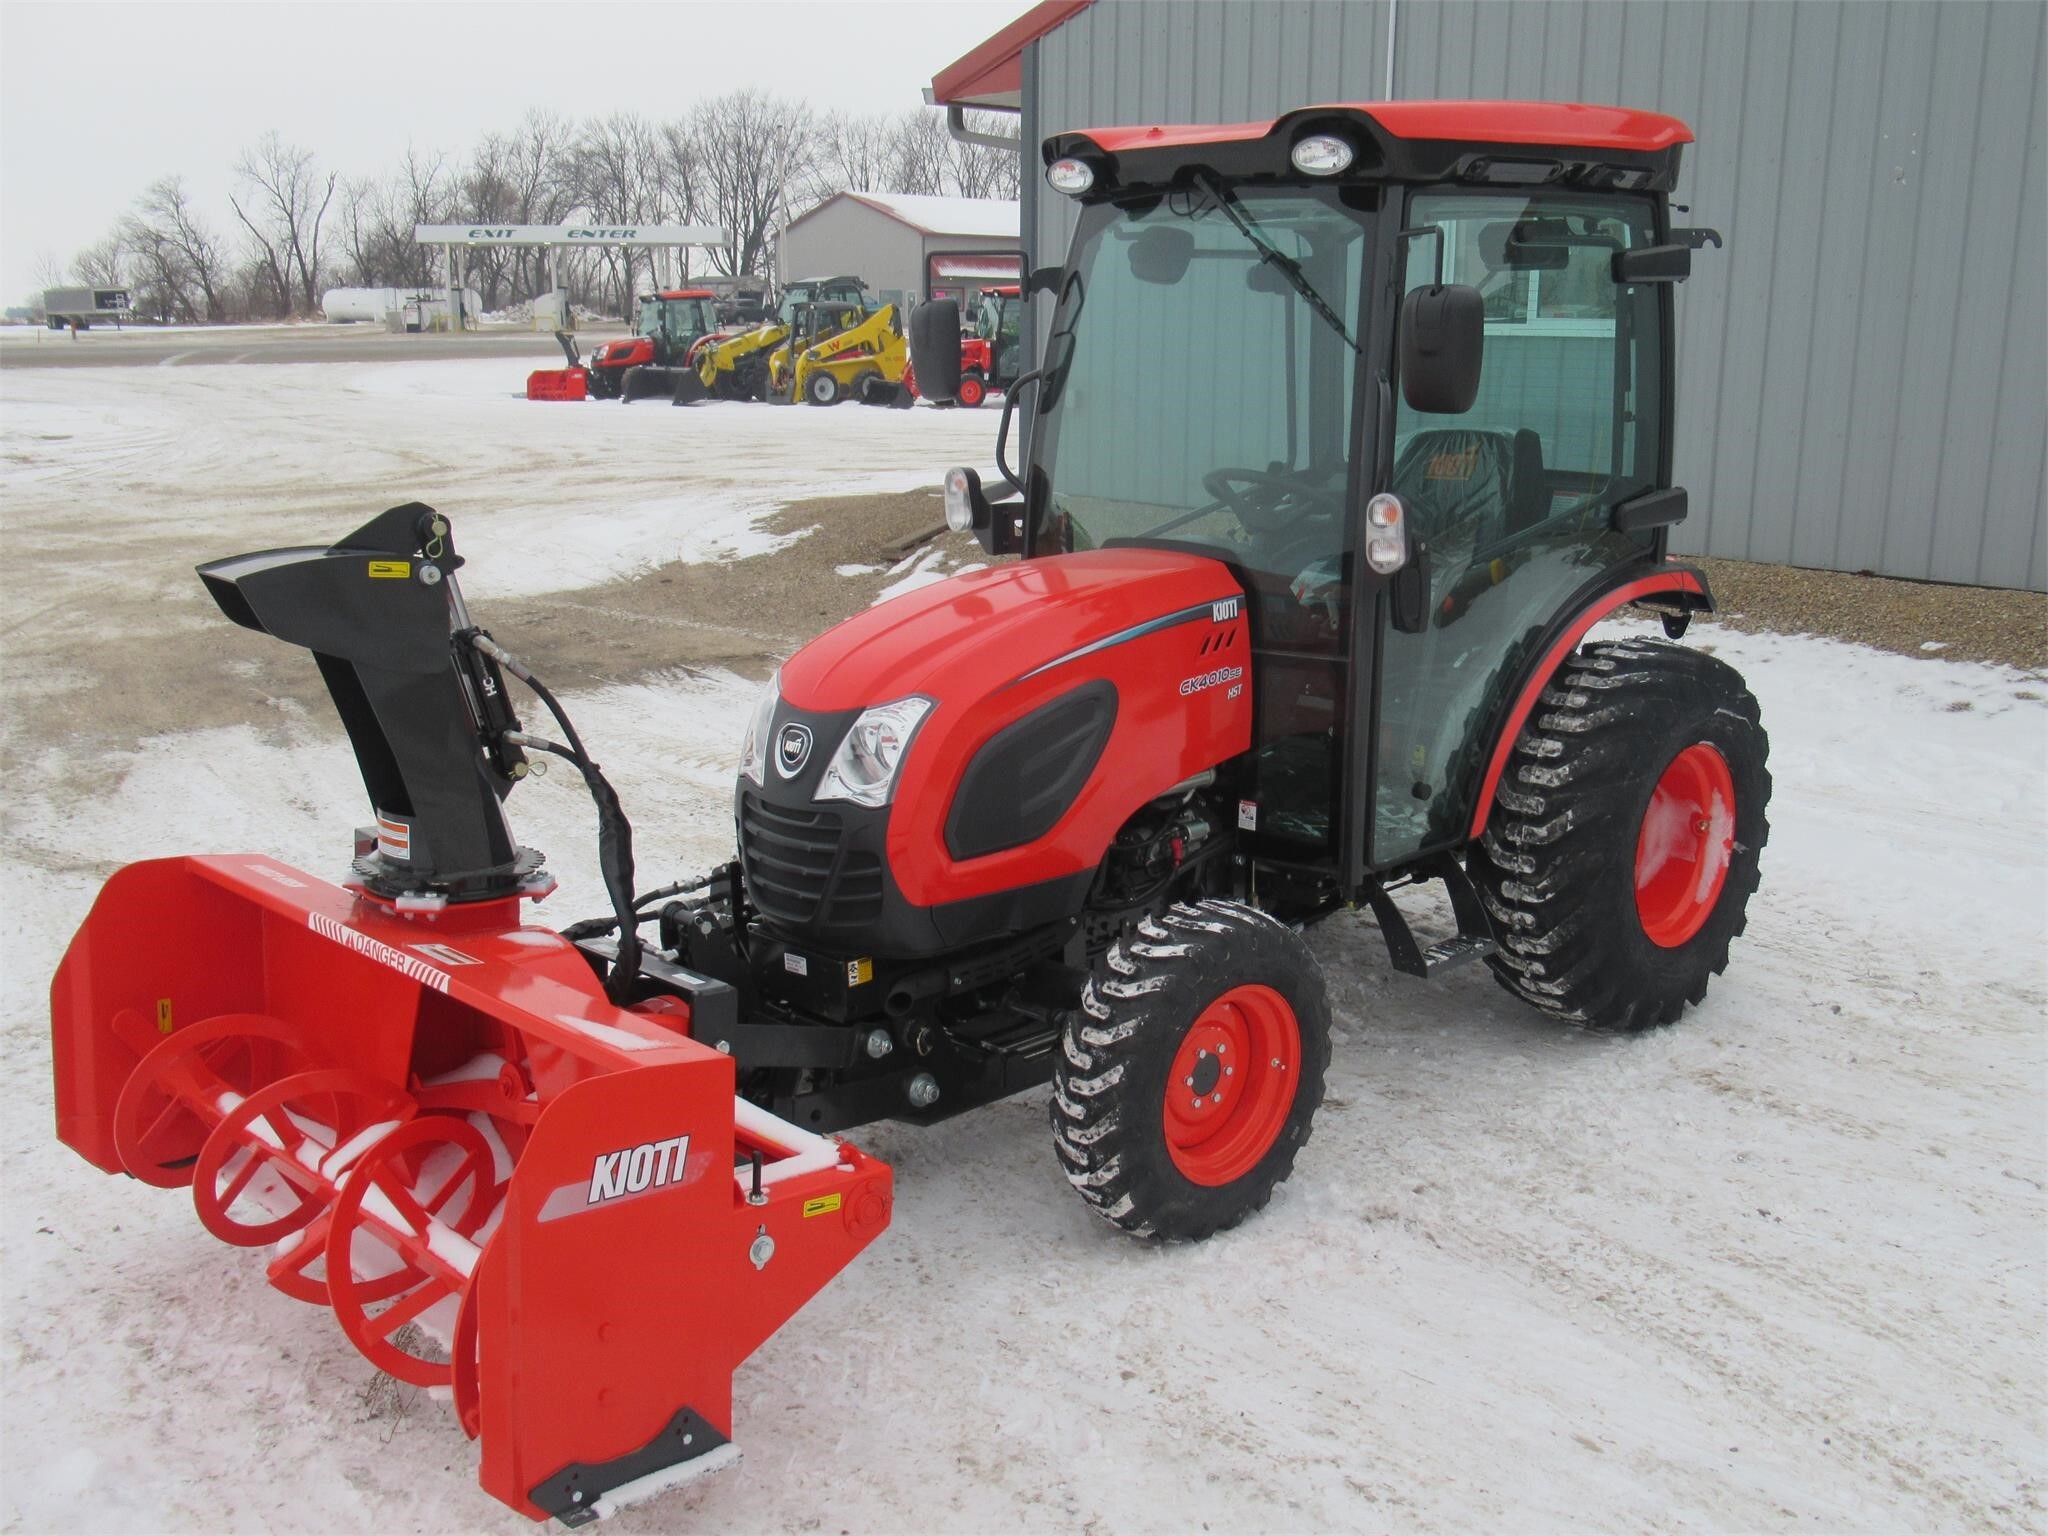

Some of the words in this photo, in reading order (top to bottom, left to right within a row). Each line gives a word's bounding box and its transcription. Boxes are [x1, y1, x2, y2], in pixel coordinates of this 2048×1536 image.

[468, 229, 517, 239] EXIT
[567, 229, 638, 239] ENTER
[1212, 599, 1238, 622] KIOTI
[1180, 667, 1243, 696] CK4010SE
[1227, 684, 1243, 700] HST
[356, 934, 406, 975] DANGER
[587, 1134, 691, 1205] KIOTI
